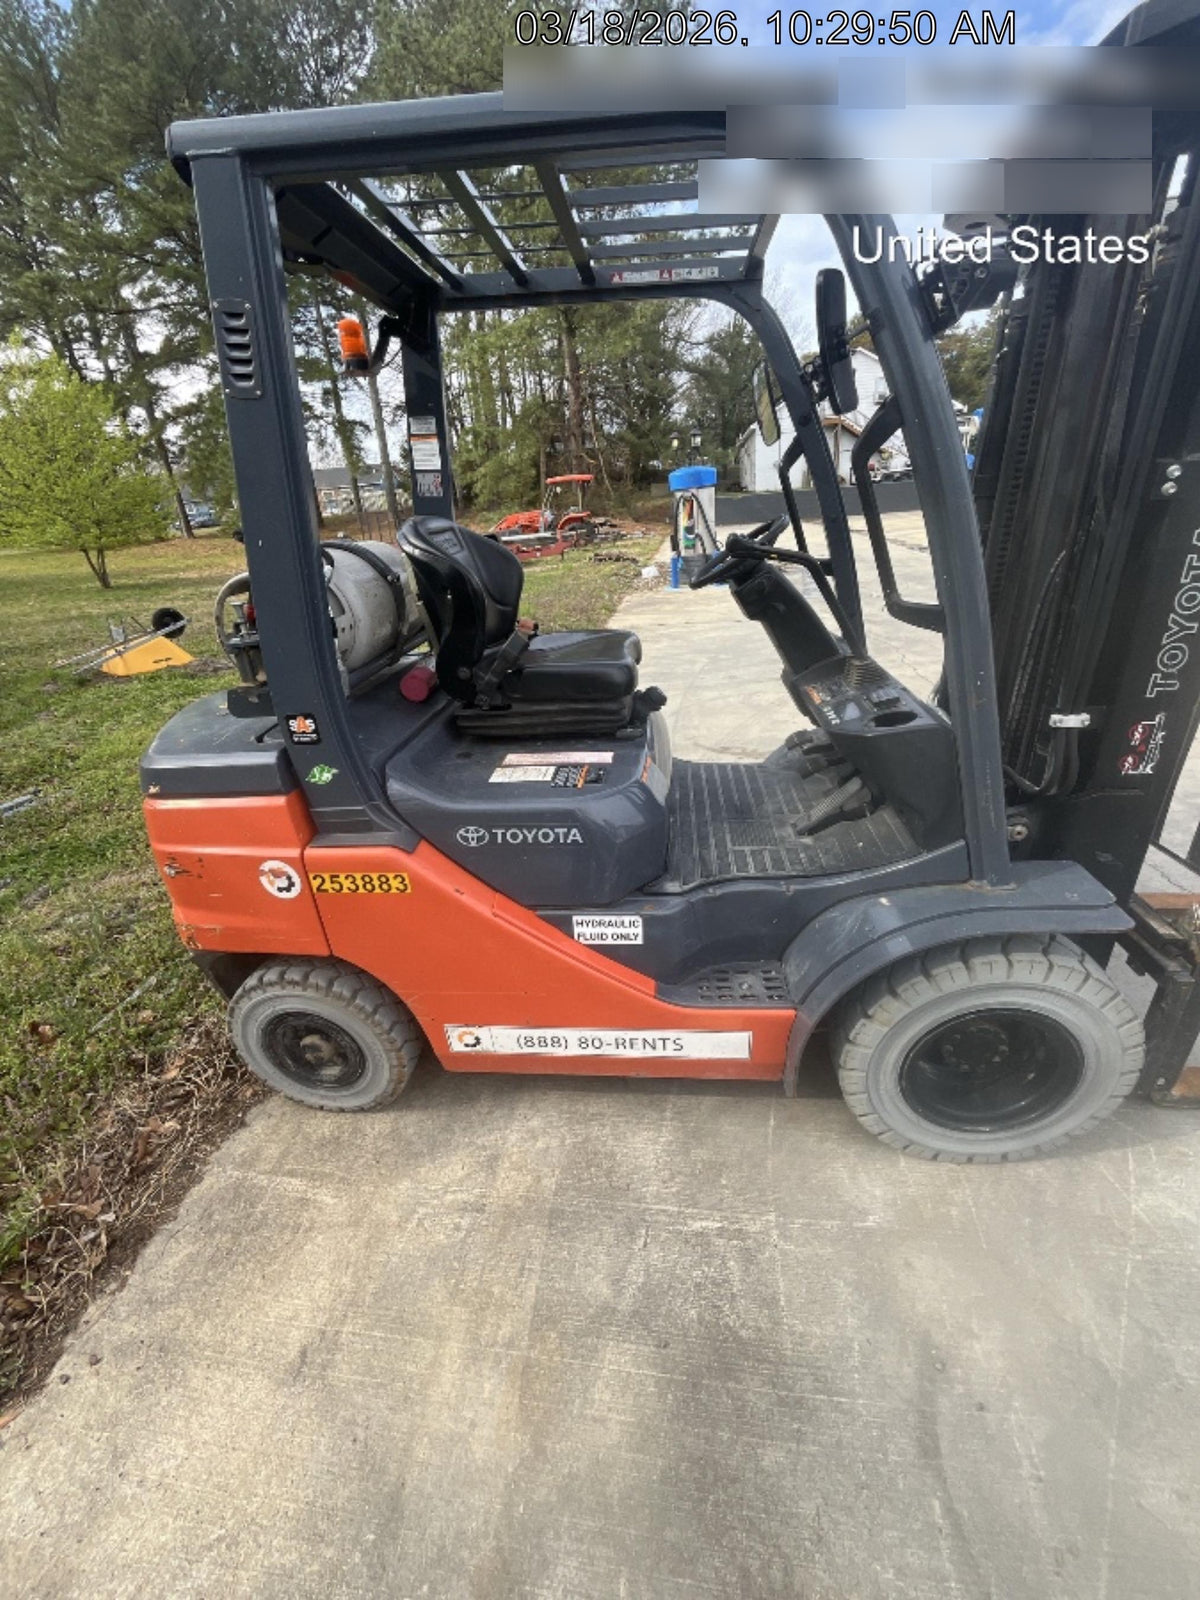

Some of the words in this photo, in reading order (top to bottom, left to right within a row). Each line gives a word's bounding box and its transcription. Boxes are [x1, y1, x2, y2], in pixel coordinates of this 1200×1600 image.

[491, 827, 584, 844] TOYOTA
[312, 874, 409, 894] 253883
[575, 918, 641, 929] HYDRAULIC
[577, 931, 609, 941] FLUID
[611, 931, 640, 941] ONLY
[516, 1034, 569, 1050] (888)
[577, 1035, 685, 1052] 80-RENTS
